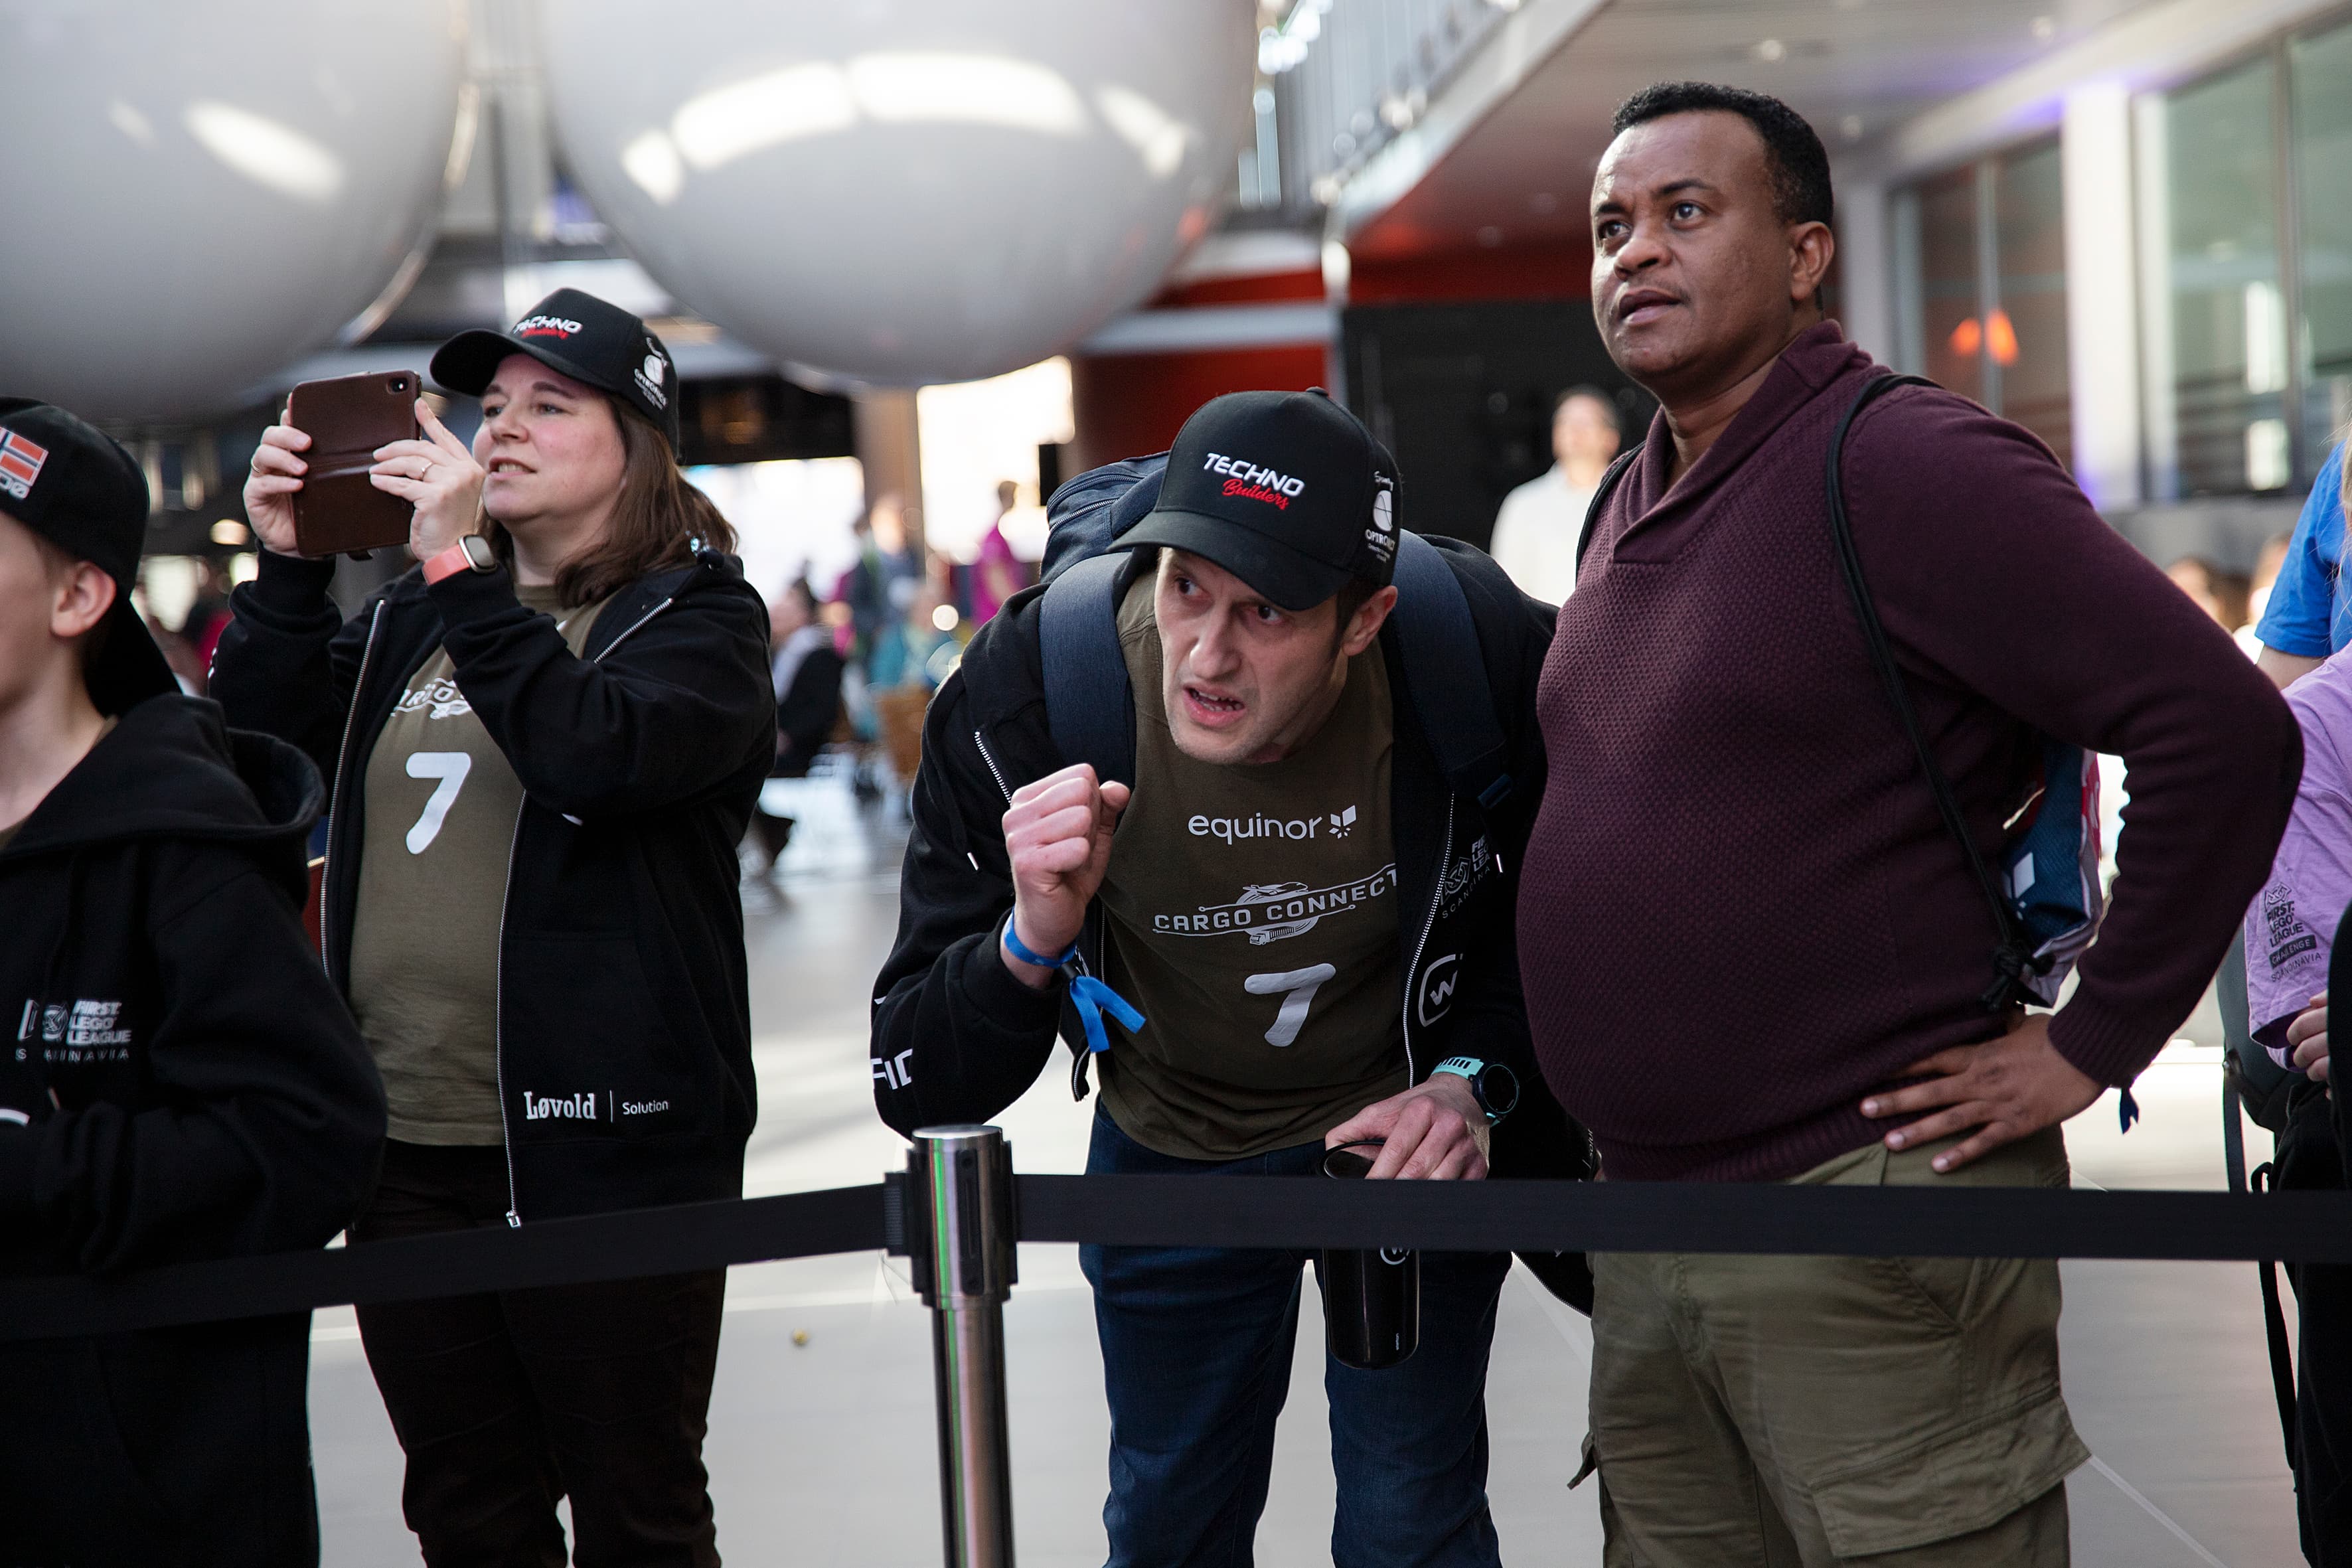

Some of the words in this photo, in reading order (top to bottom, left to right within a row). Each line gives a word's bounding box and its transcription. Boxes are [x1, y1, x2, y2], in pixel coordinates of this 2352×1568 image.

[1204, 452, 1305, 497] TECHNO
[1222, 479, 1289, 510] Builders
[406, 752, 471, 854] 7
[1188, 812, 1323, 845] equinor
[1154, 908, 1251, 931] CARGO
[1267, 868, 1397, 921] CONNECT
[2269, 914, 2294, 934] LEGO
[2269, 923, 2304, 947] LEAGUE
[1244, 963, 1337, 1048] 7
[66, 1030, 132, 1046] LEAGUE
[523, 1091, 597, 1121] Løvold
[621, 1100, 669, 1116] Solution
